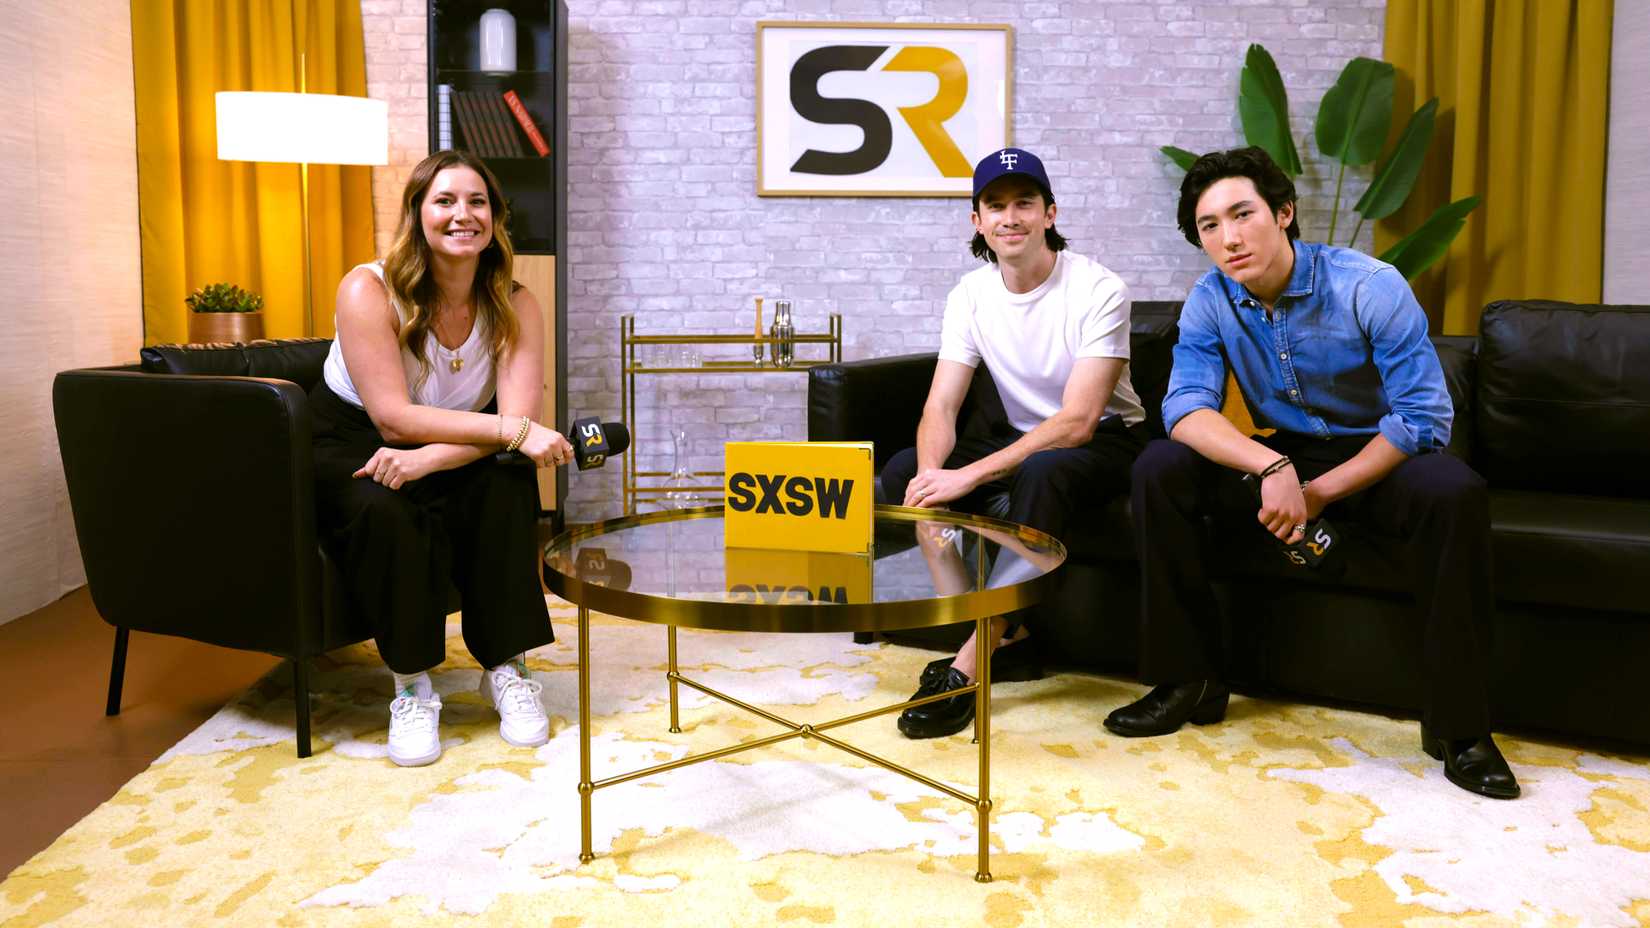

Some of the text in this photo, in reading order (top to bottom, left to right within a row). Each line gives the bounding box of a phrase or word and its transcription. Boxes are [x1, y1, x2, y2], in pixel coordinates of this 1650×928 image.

[790, 45, 974, 178] SR
[581, 423, 603, 447] SR
[728, 472, 854, 520] SXSW
[1306, 528, 1332, 556] SR
